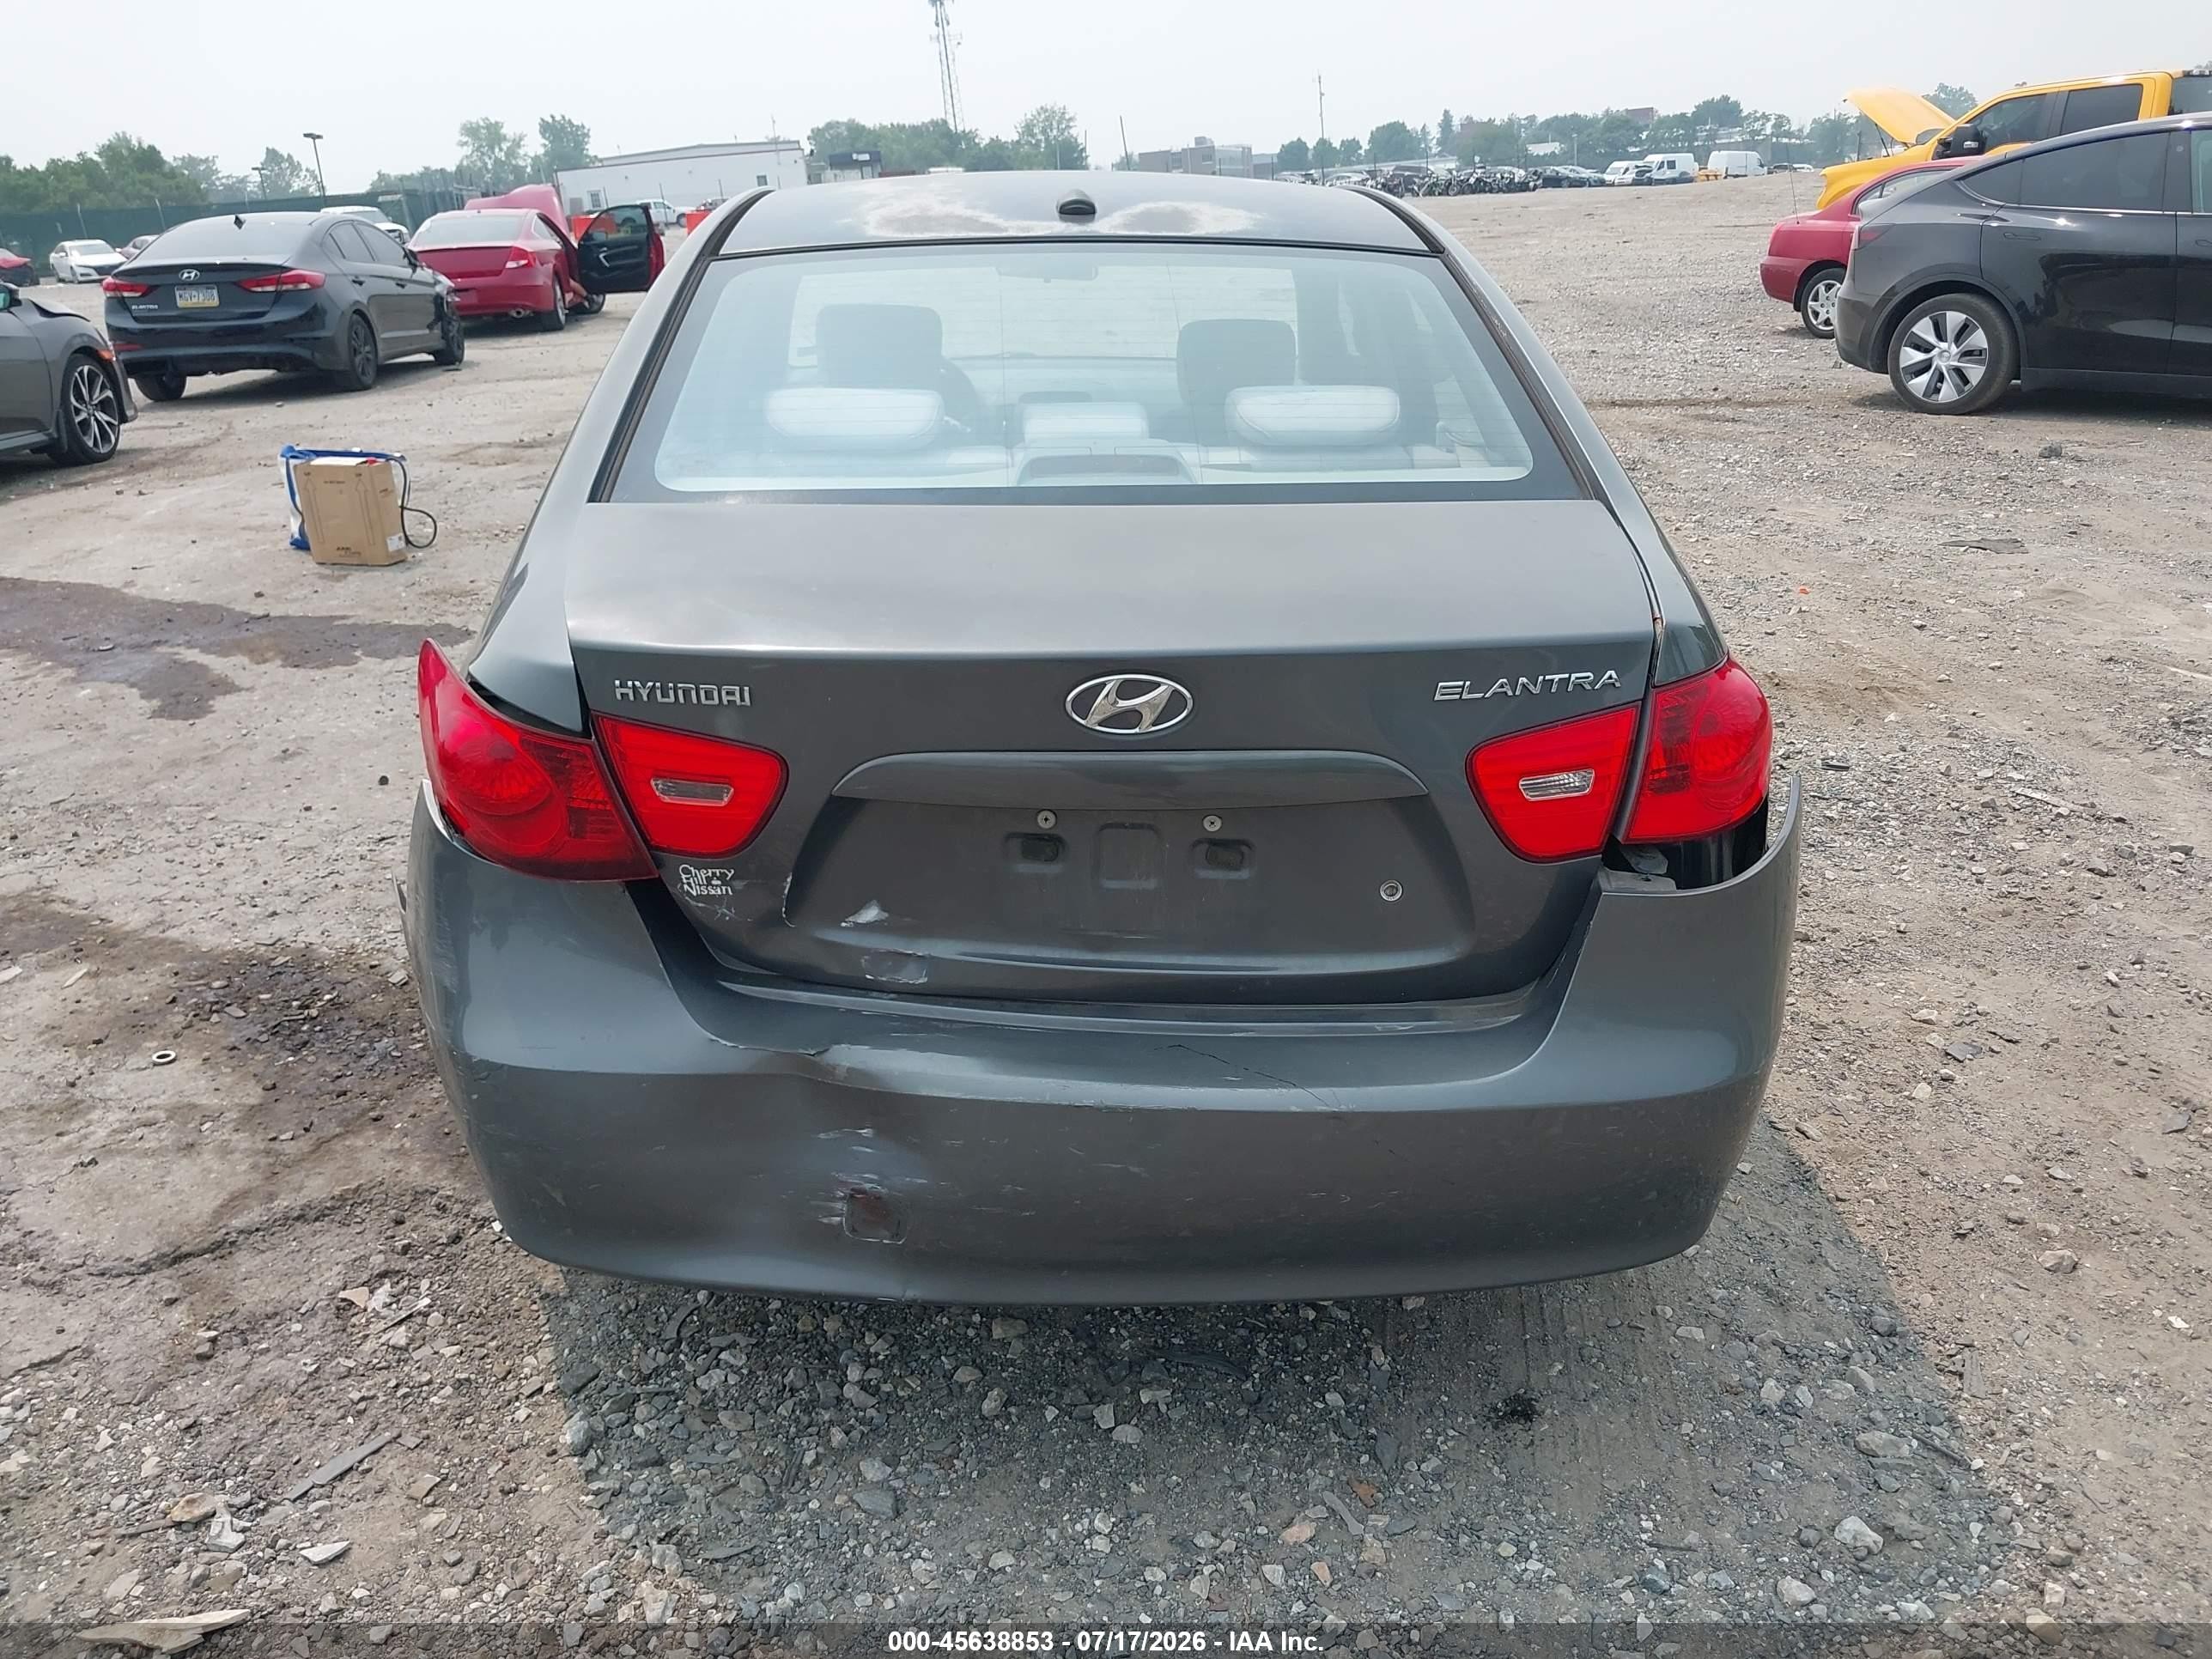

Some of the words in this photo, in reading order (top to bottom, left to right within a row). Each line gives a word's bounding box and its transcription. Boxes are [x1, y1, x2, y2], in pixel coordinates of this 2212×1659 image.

[614, 679, 751, 707] HYUNDAI
[1433, 670, 1622, 701] ELANTRA
[678, 864, 735, 881] Cherry
[684, 884, 733, 896] Nissan
